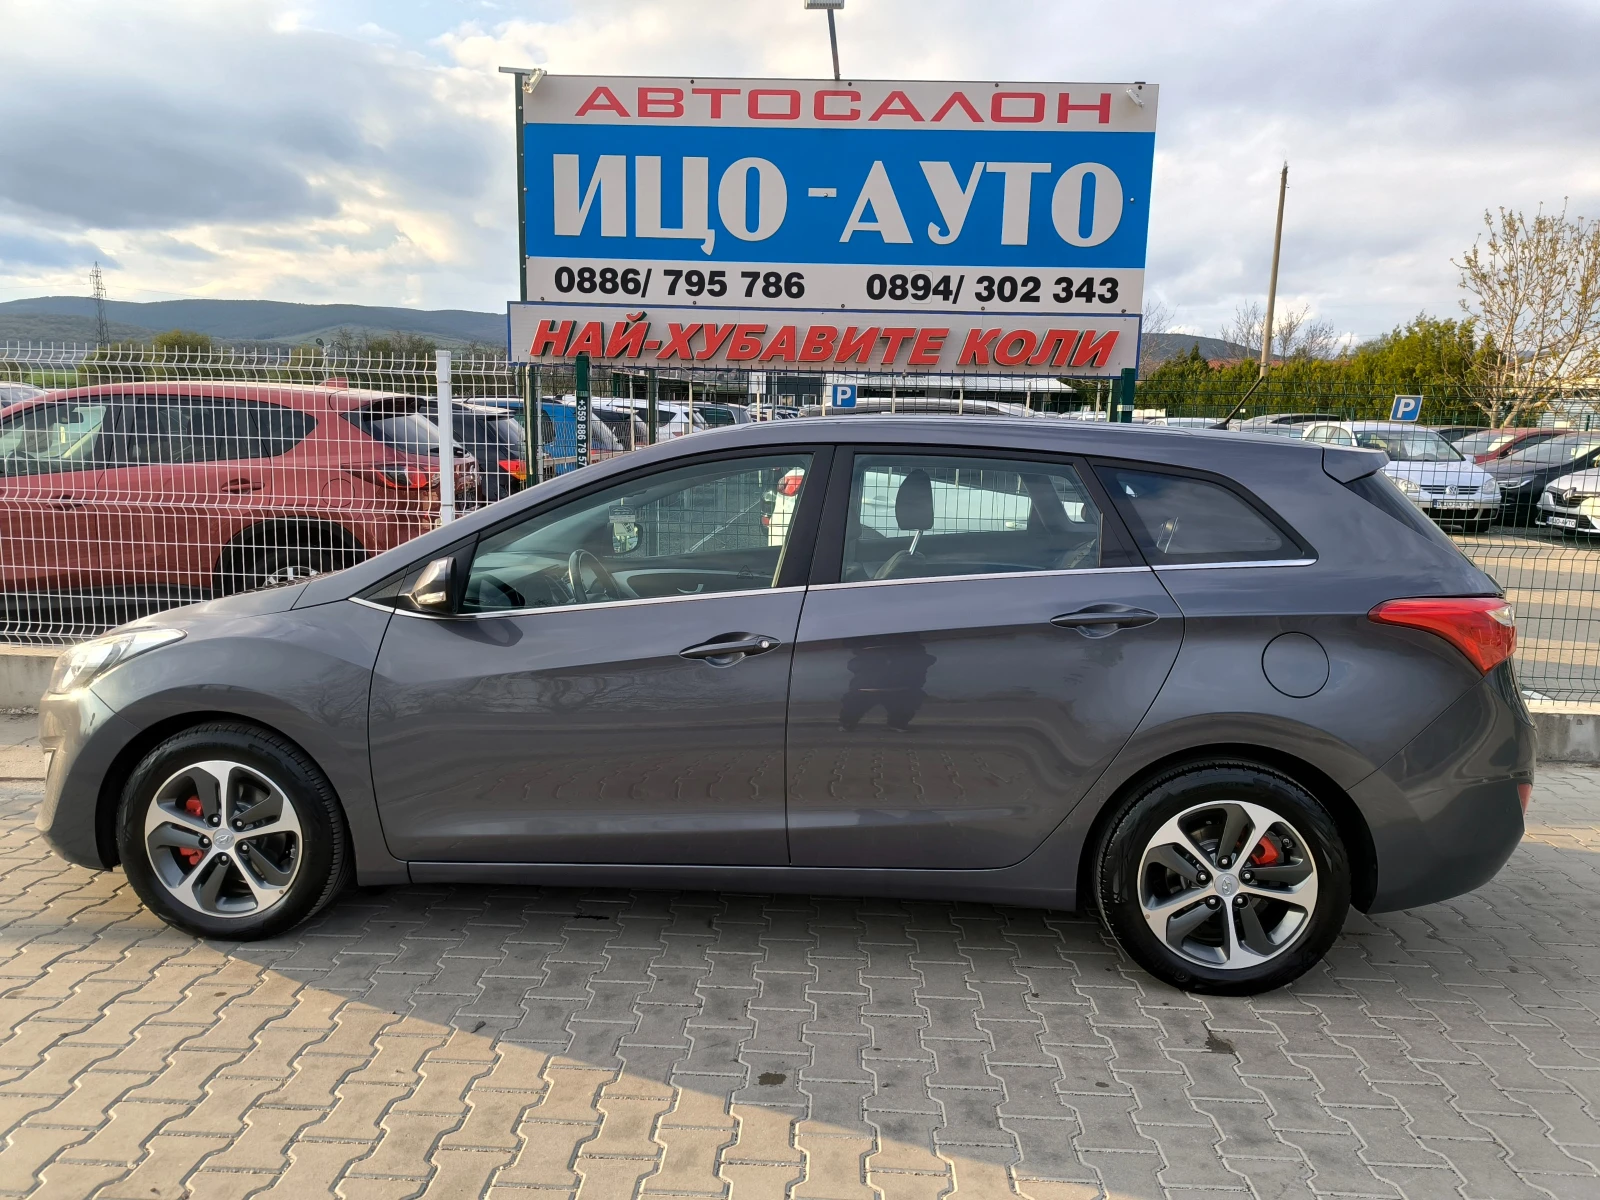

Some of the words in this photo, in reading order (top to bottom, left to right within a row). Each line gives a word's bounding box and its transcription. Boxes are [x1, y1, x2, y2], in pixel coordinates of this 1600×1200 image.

[576, 86, 1112, 125] АВТОСАЛОН
[554, 266, 652, 298] 0886/
[663, 269, 728, 298] 795
[740, 271, 805, 300] 786
[866, 273, 965, 305] 0894/
[974, 275, 1042, 304] 302
[1052, 276, 1119, 305] 343
[529, 311, 951, 366] НАЙ-ХУБАВИТЕ
[958, 328, 1121, 368] КОЛИ
[836, 386, 852, 406] P
[577, 399, 587, 422] +359
[1396, 398, 1416, 419] P
[577, 423, 587, 441] 886
[577, 442, 587, 454] 79
